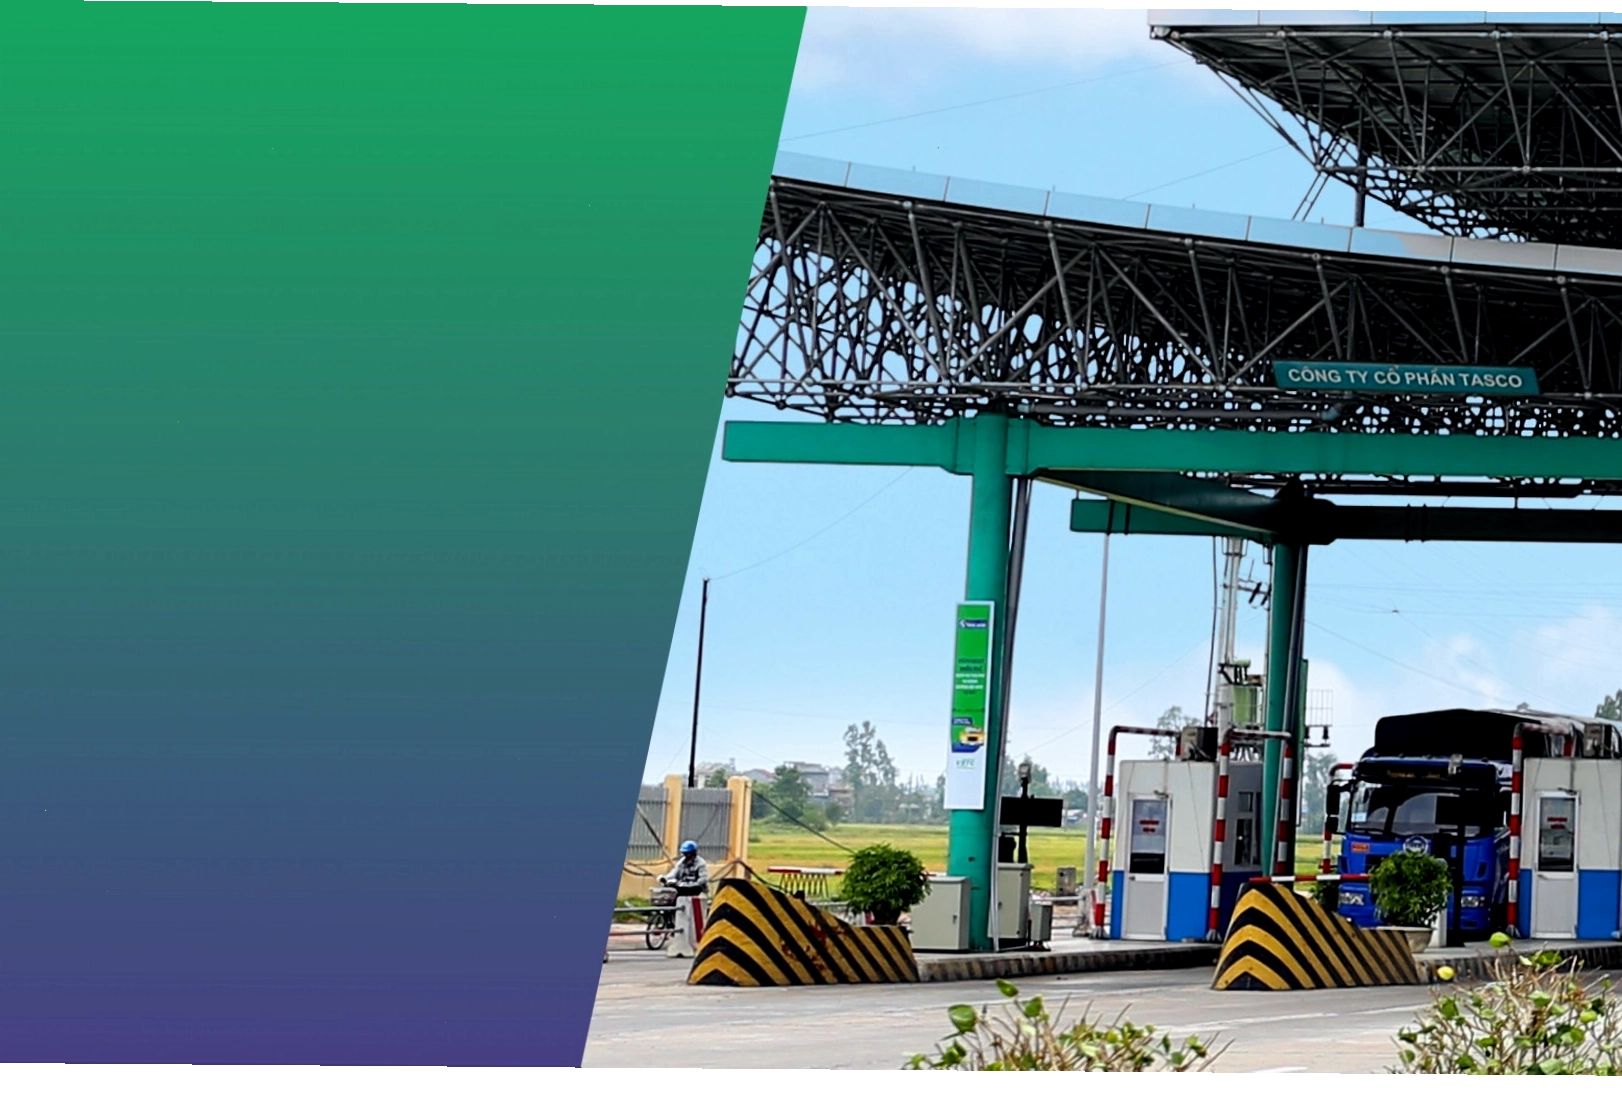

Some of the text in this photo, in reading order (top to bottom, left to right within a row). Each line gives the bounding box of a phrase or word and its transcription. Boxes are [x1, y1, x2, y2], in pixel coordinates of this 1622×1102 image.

[1289, 366, 1341, 383] CÔNG
[1345, 370, 1368, 384] TY
[1459, 373, 1523, 388] TASCO
